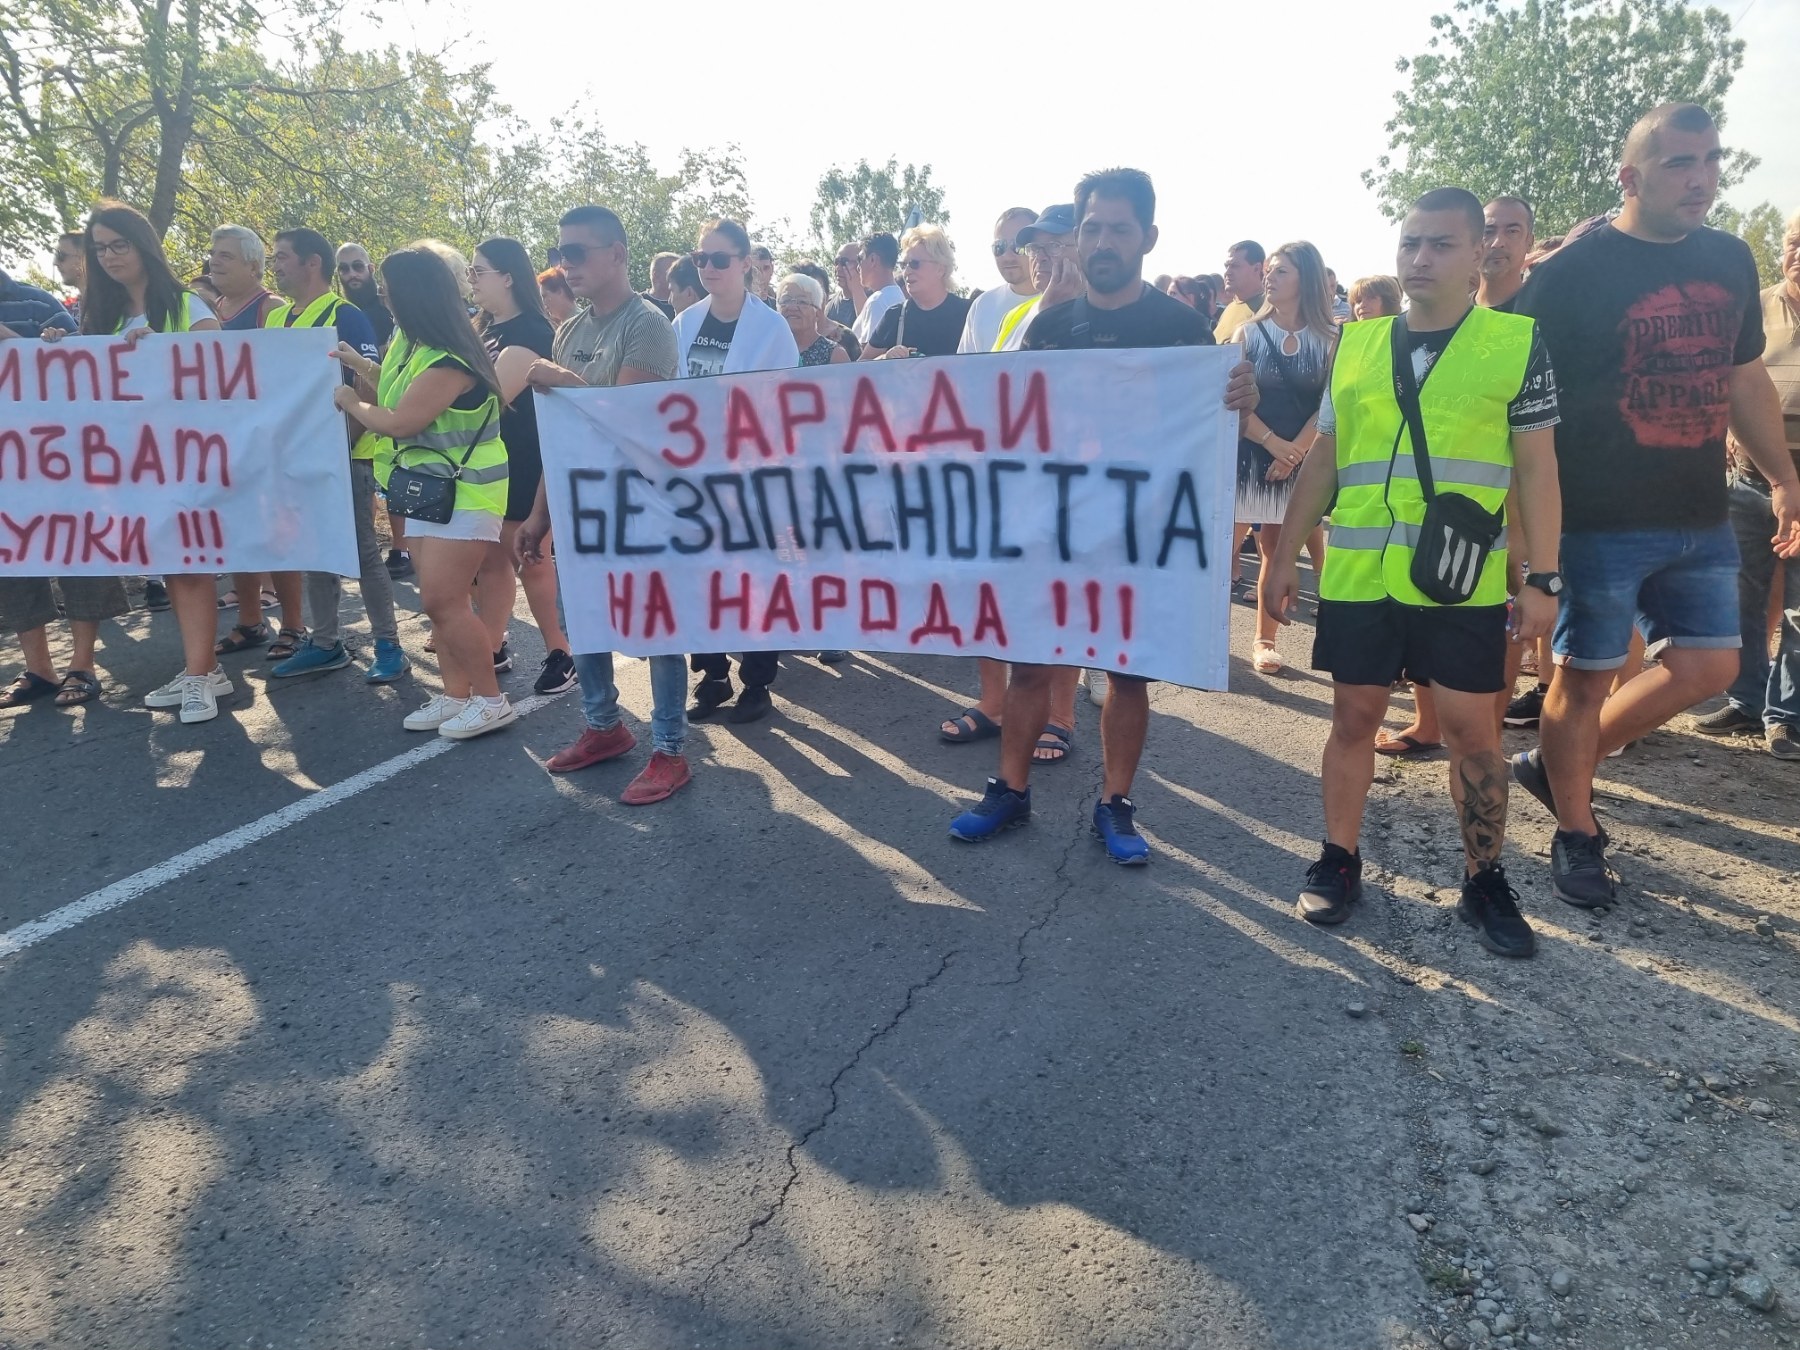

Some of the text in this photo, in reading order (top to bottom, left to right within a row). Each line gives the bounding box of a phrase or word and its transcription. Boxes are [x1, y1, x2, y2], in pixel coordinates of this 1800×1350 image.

[172, 340, 257, 401] НИ
[658, 369, 1050, 467] ЗАРАДИ
[0, 510, 224, 566] УПКИ !!!
[569, 460, 1208, 570] БЕЗОПАСНОСТТА
[607, 570, 1134, 666] НА НАРОДА !!!
